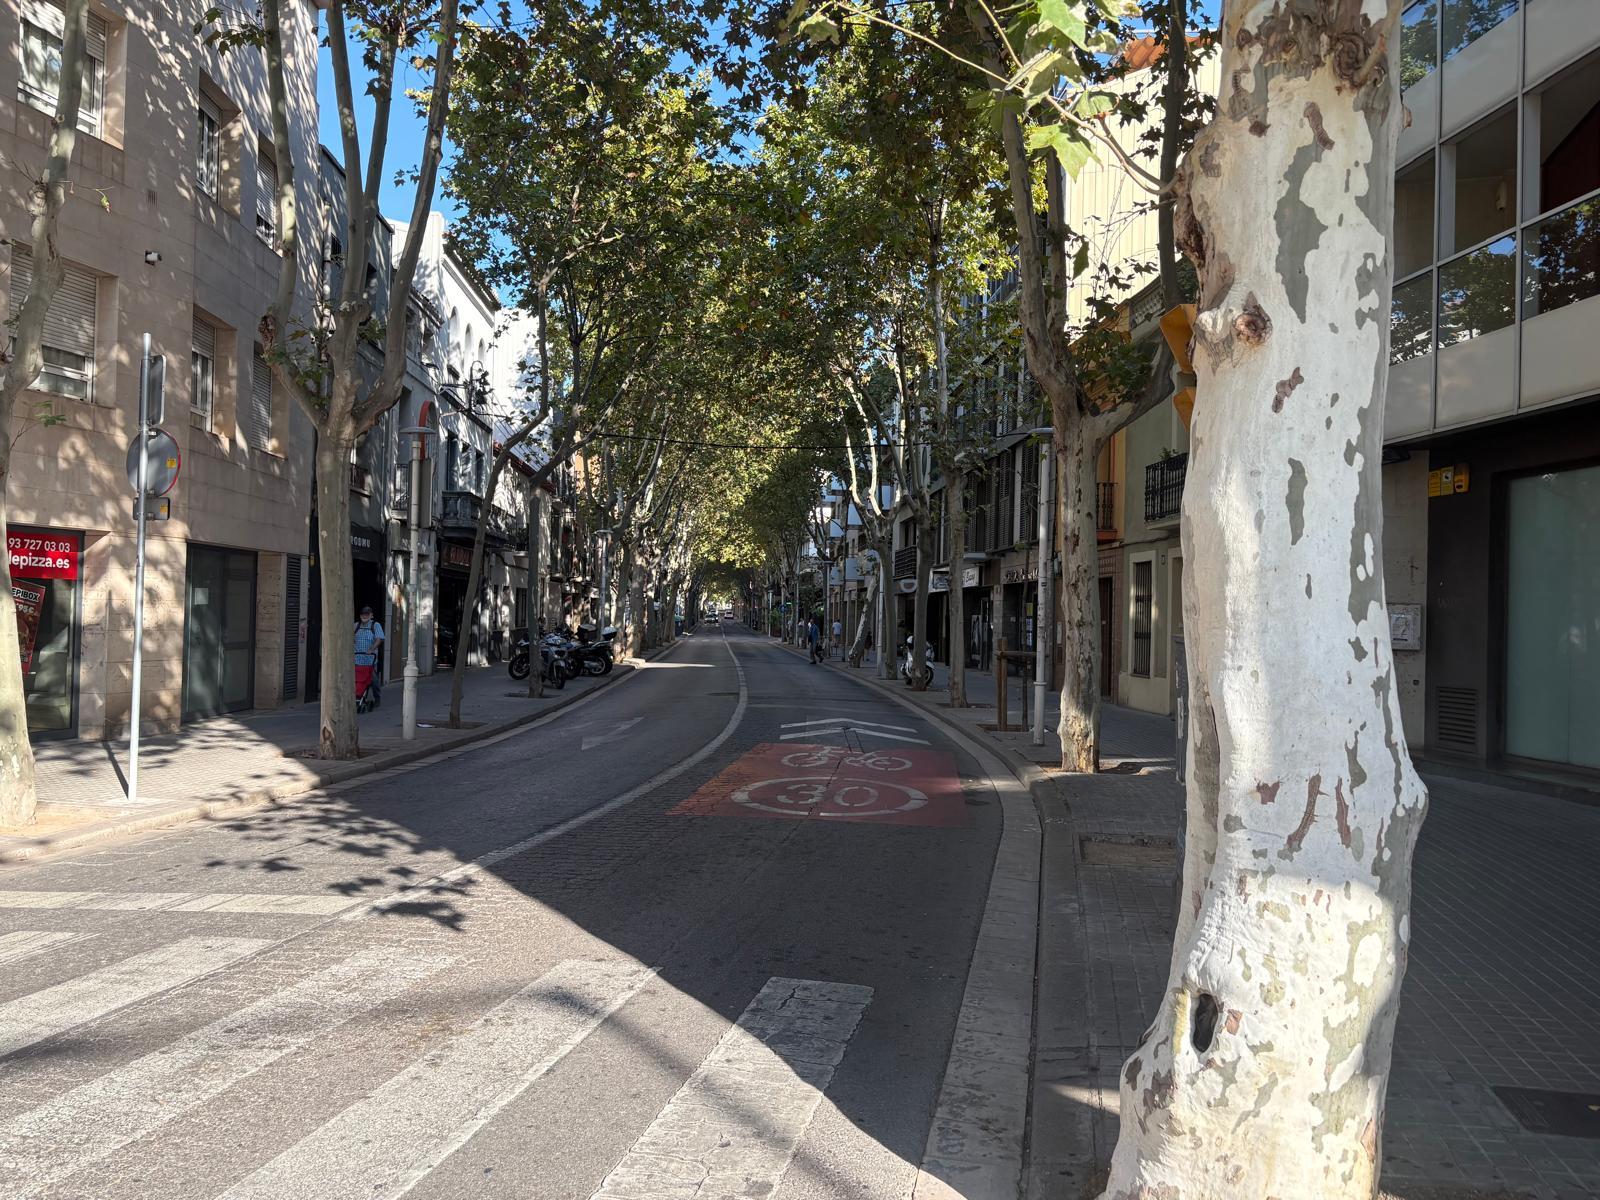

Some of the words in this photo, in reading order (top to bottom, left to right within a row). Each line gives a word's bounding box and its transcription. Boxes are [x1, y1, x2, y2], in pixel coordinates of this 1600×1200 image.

[8, 537, 21, 549] 93
[23, 538, 42, 550] 727
[44, 541, 57, 552] 03
[58, 542, 71, 553] 03
[8, 550, 70, 569] lepizza.es
[12, 587, 40, 602] EPIBOX
[776, 783, 879, 807] 30
